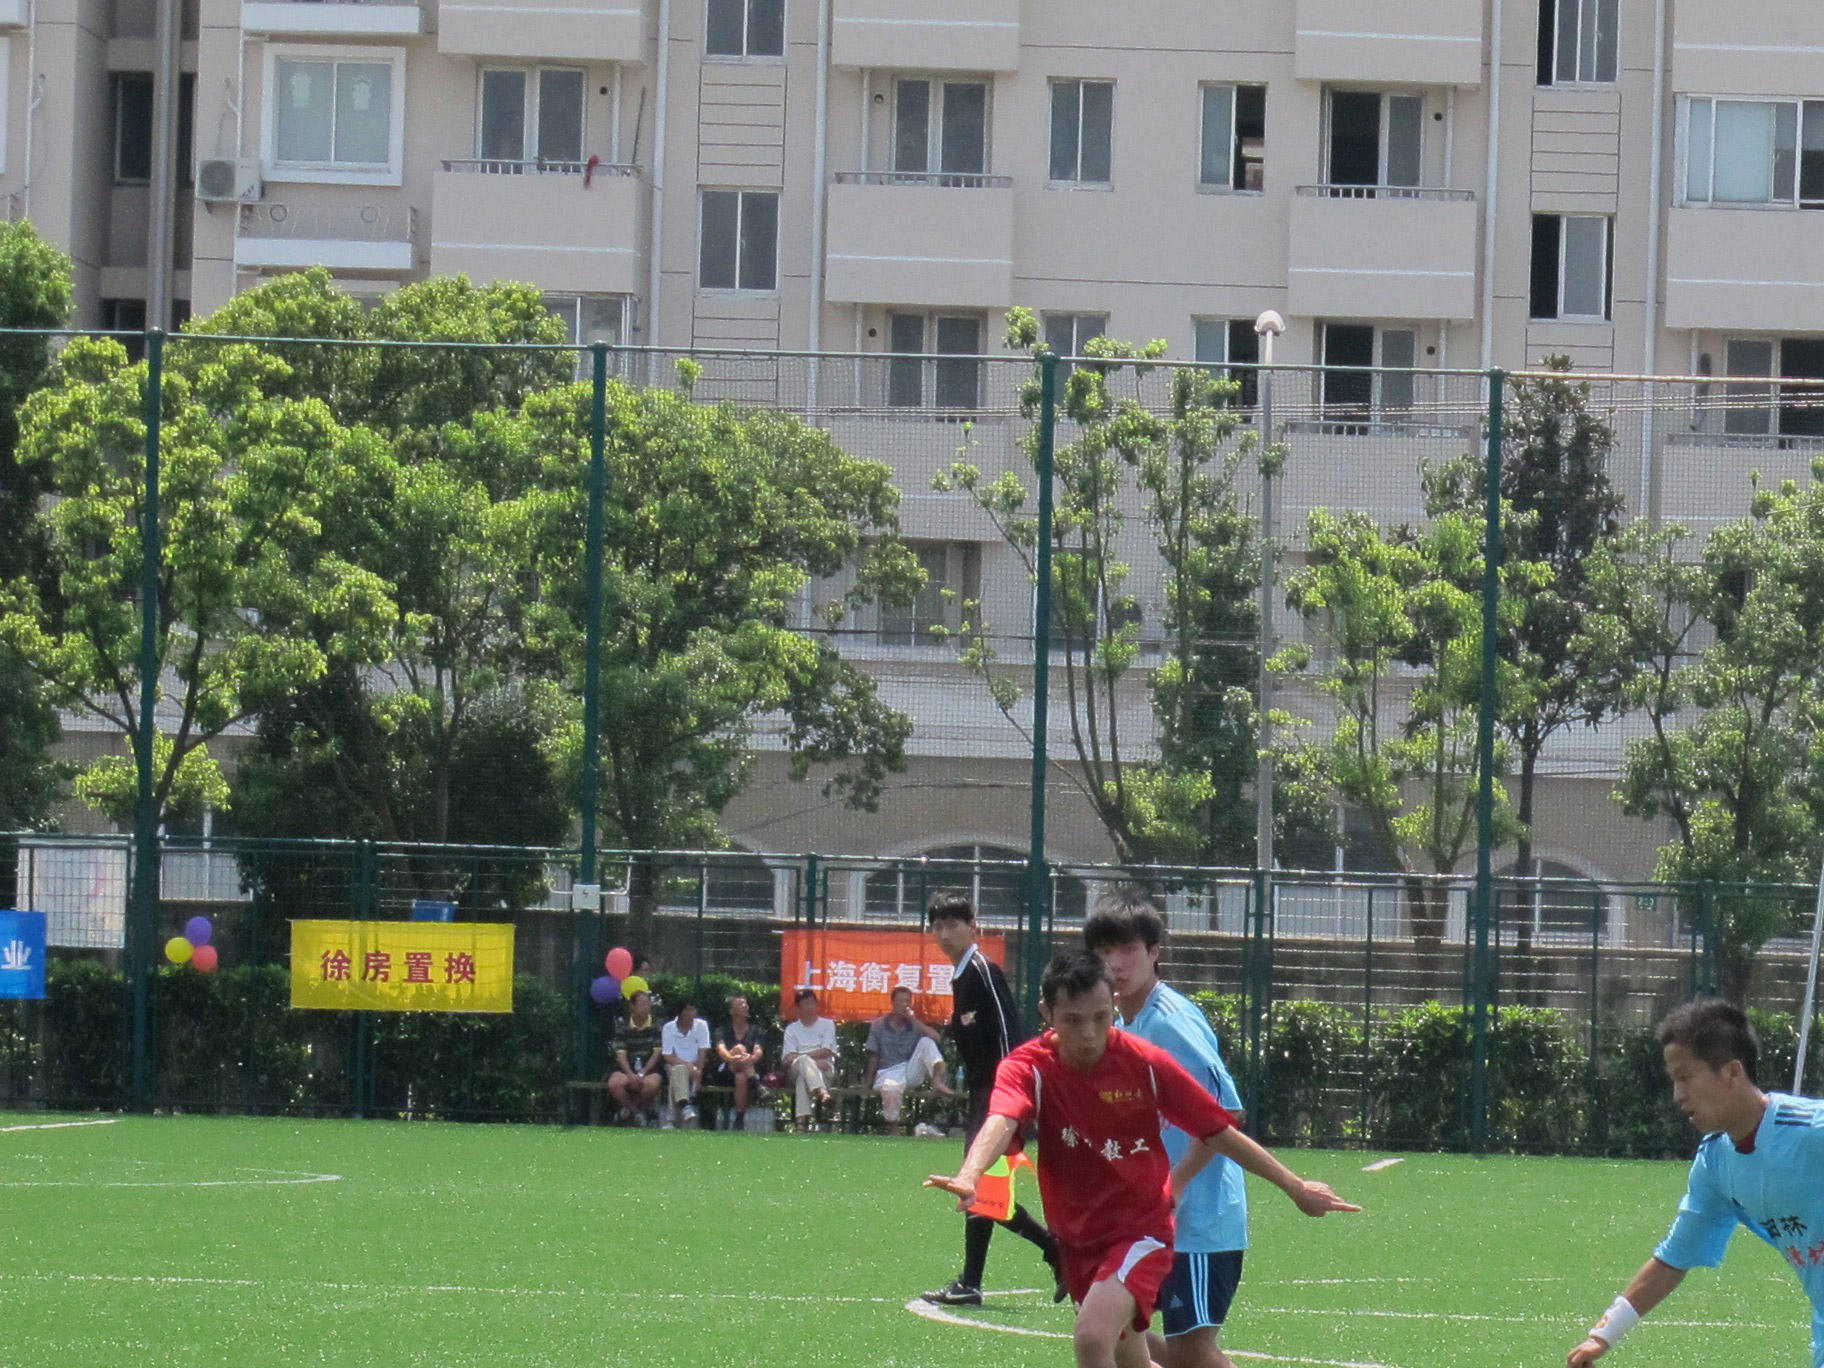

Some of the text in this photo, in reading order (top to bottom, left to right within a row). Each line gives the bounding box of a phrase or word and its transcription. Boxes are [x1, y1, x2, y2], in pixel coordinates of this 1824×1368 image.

[1, 940, 32, 970] 业
[320, 949, 476, 984] 徐房置换
